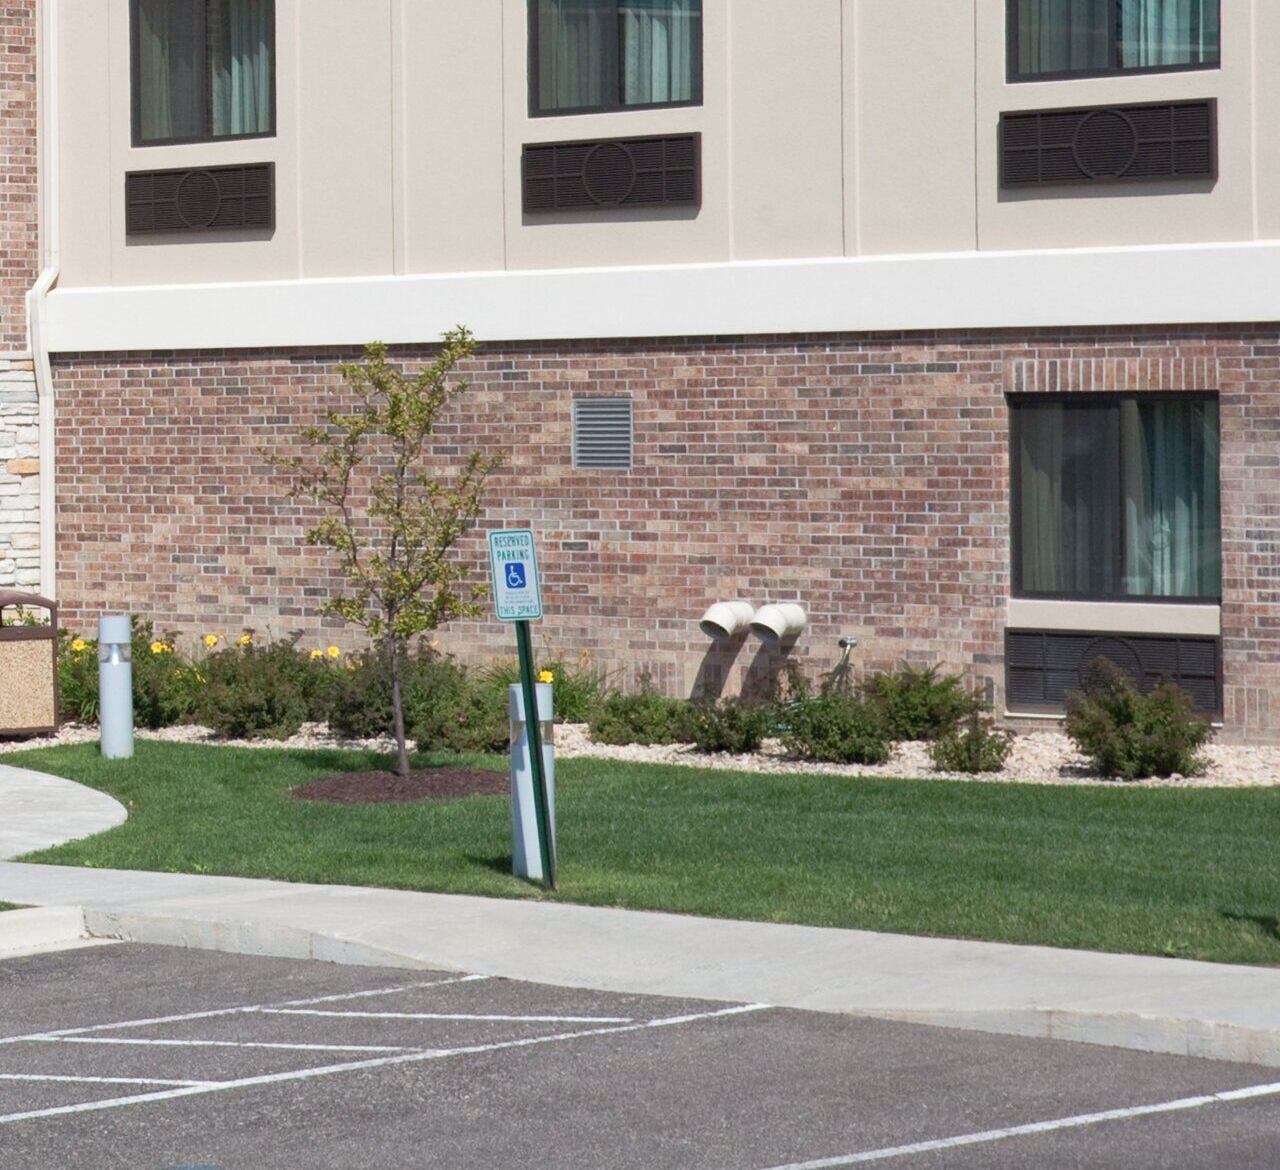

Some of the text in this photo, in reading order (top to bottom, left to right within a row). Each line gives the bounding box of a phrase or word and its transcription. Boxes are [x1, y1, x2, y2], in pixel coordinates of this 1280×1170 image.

[494, 535, 529, 548] RESERVED
[496, 549, 529, 562] PARKING
[500, 604, 539, 615] THIS SPACE
